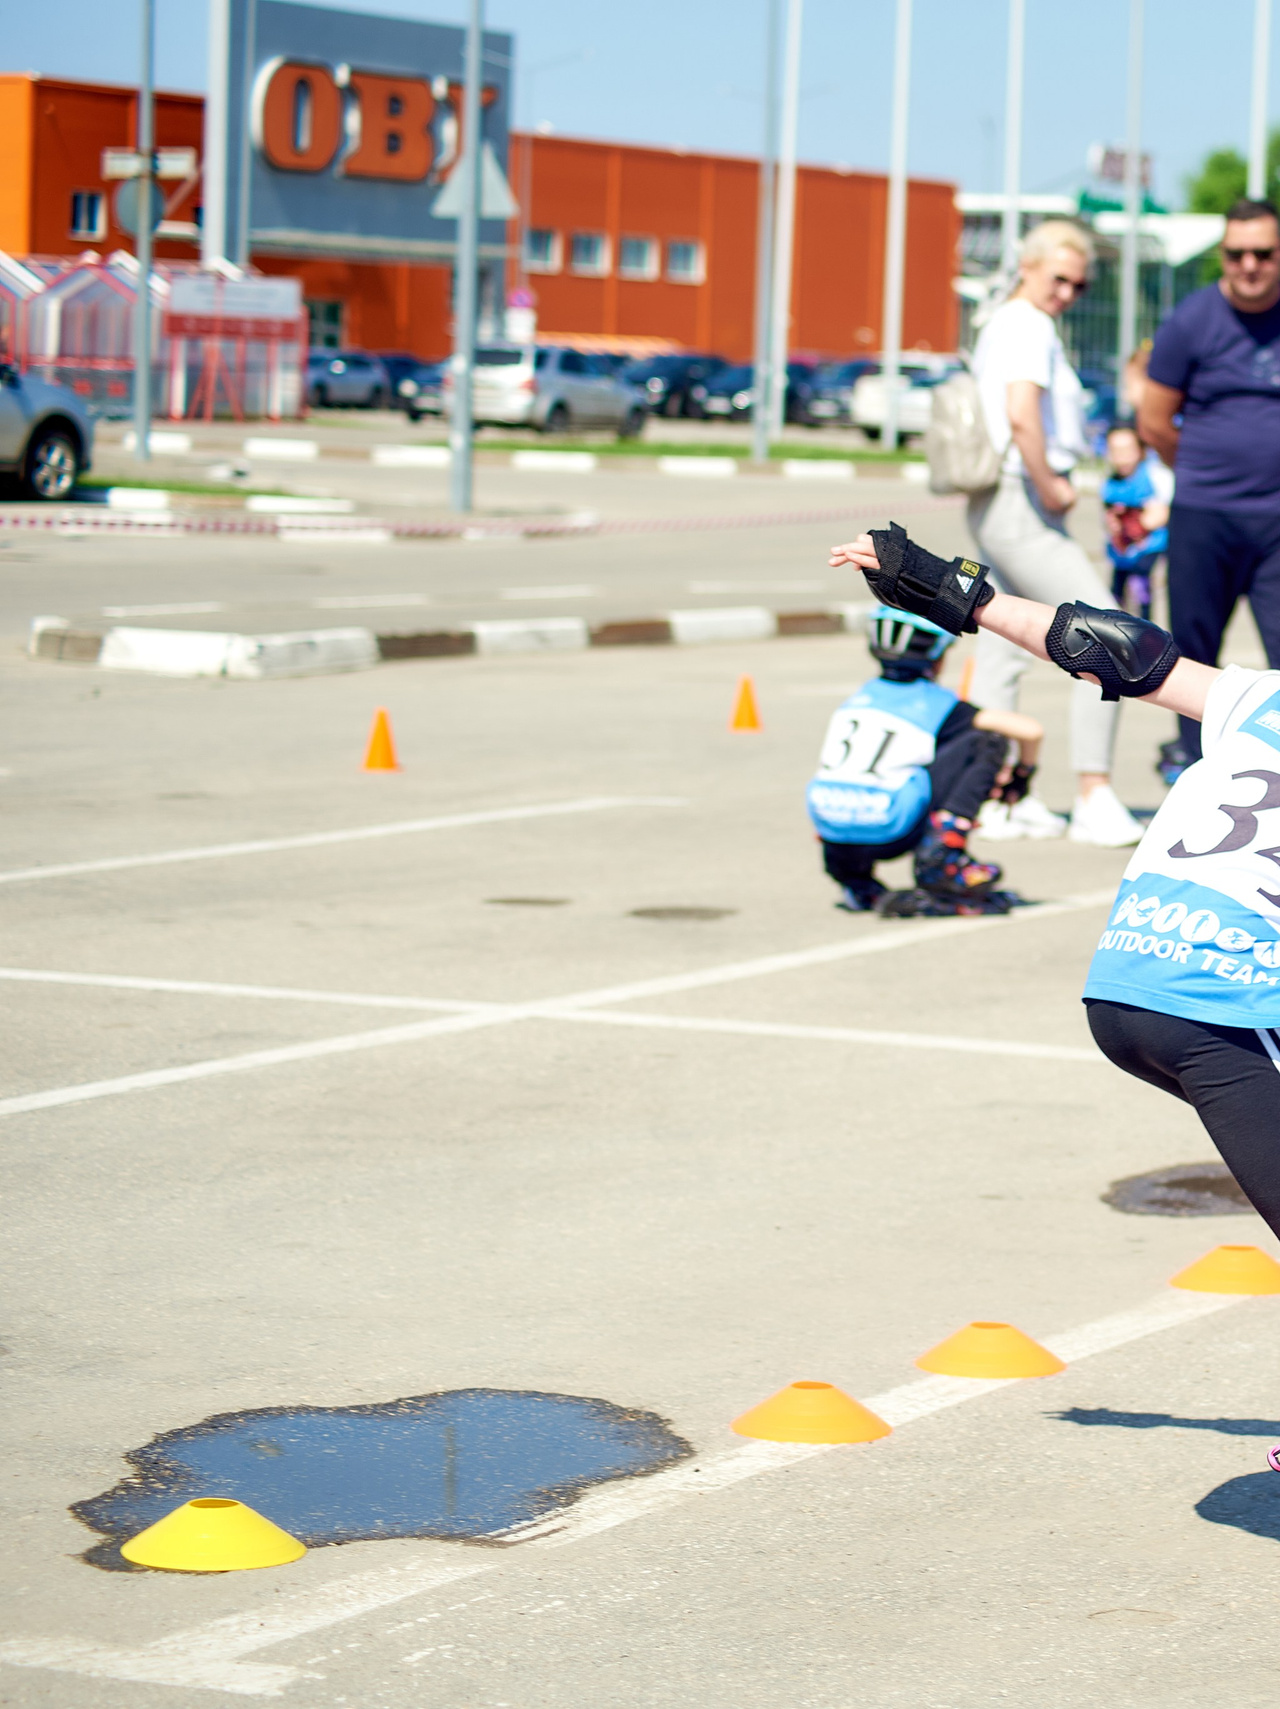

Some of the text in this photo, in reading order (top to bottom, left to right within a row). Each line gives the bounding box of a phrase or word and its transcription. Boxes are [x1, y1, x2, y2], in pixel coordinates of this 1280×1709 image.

[822, 718, 899, 778] 31
[1098, 930, 1280, 986] OUTDOOR TEAM
